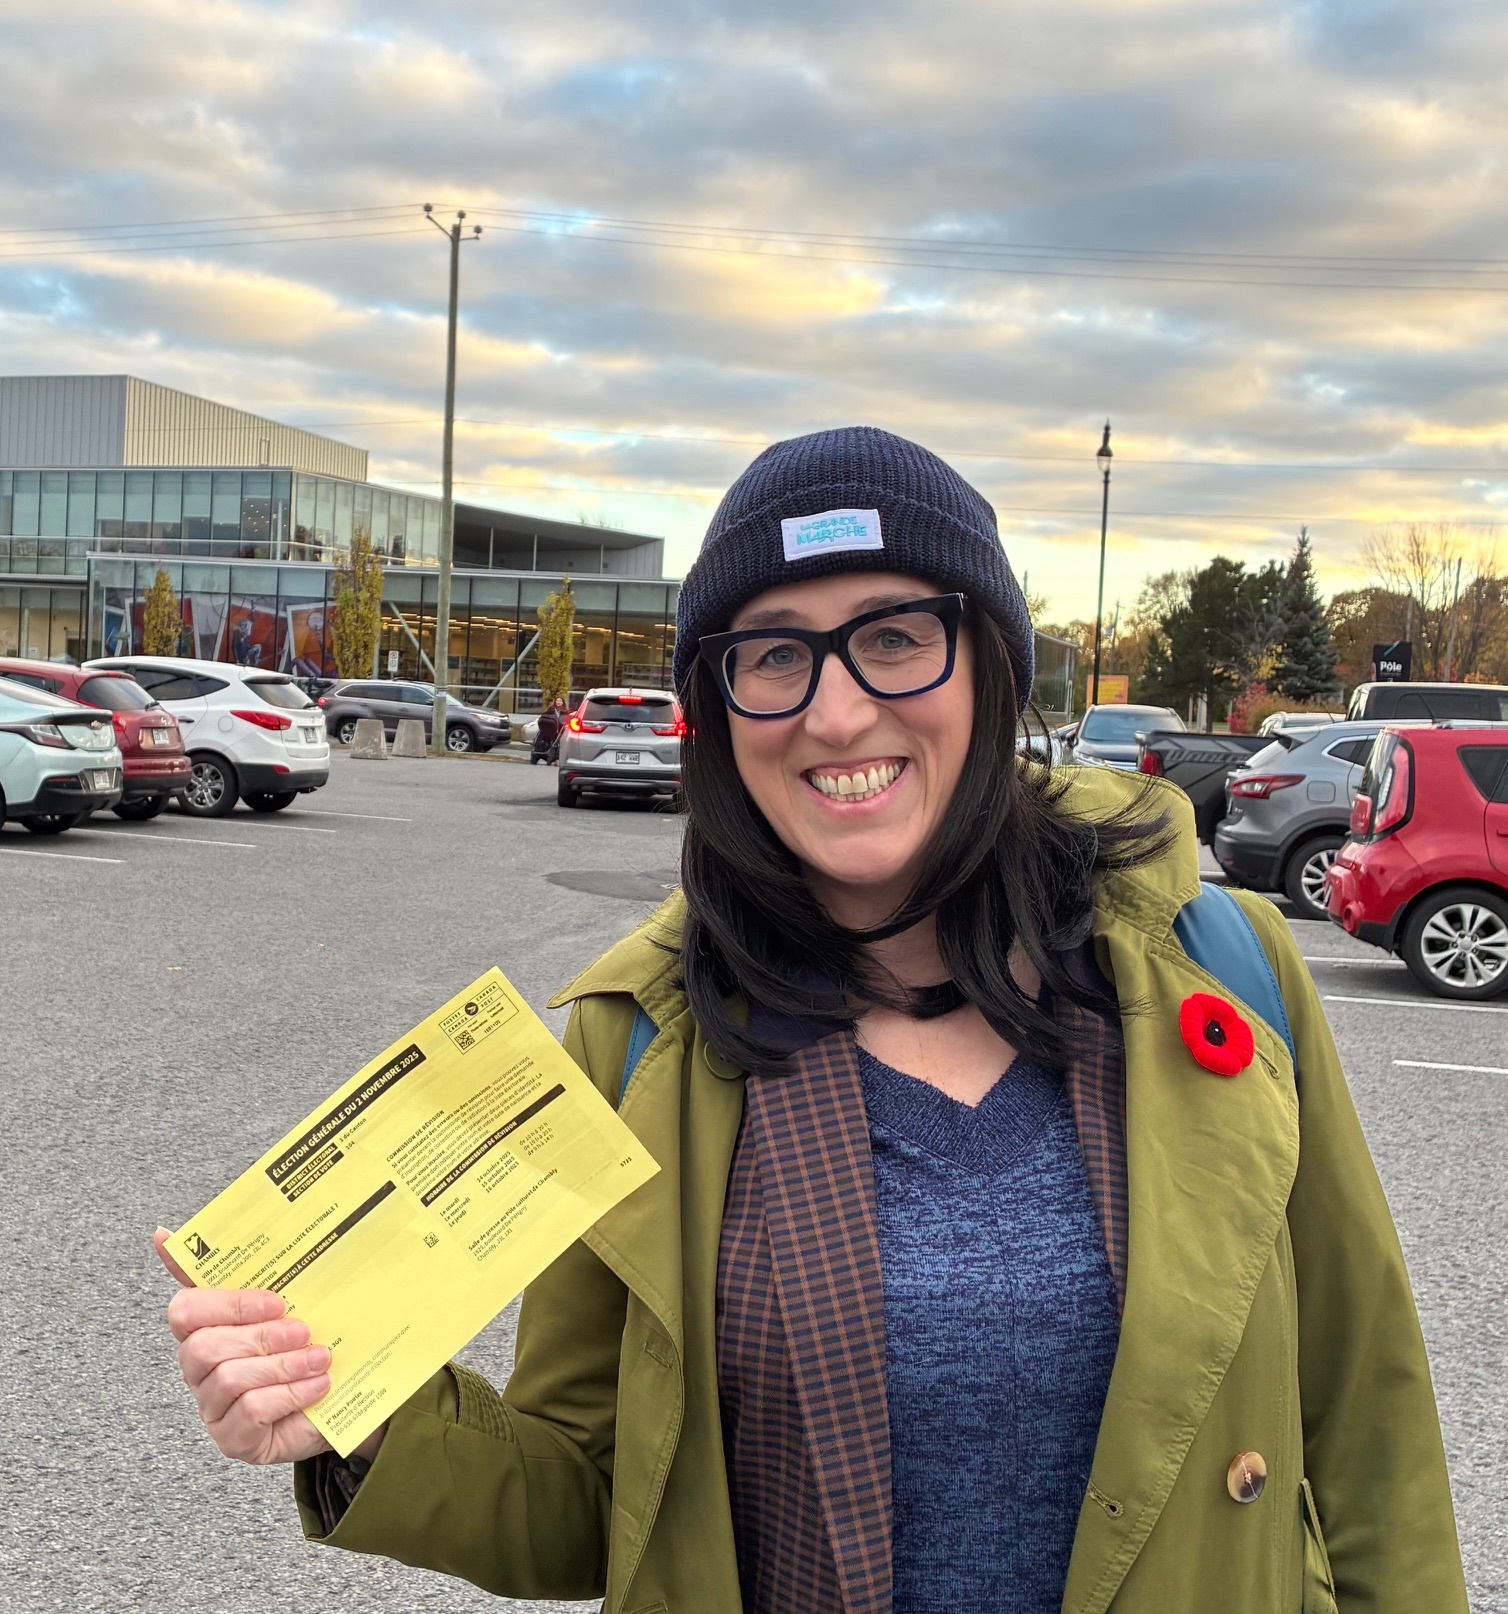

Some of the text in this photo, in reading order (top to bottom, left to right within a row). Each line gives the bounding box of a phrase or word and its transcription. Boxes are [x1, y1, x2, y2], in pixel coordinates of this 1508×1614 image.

[797, 525, 867, 545] MARCHE
[1380, 661, 1402, 672] Pôle
[475, 985, 496, 1001] CANADA
[480, 996, 493, 1007] POST
[447, 1016, 468, 1032] CANADA
[272, 1143, 309, 1178] ÉLECTION
[308, 1111, 346, 1146] GÉNÉRALE
[343, 1101, 356, 1115] DU
[360, 1064, 401, 1100] NOVEMBRE
[399, 1050, 419, 1068] 2025
[386, 1109, 444, 1162] COMMISSION DE RÉVISION
[286, 1145, 335, 1189] DISTRICT ÉLECTORAL
[425, 1180, 447, 1201] HORAIRE
[458, 1143, 488, 1171] COMMISSION
[486, 1137, 495, 1146] DE
[493, 1120, 517, 1140] RÉVISION
[293, 1176, 314, 1197] SECTION
[319, 1159, 333, 1172] VOTE
[537, 1168, 557, 1186] Chambly
[275, 1249, 286, 1260] SUR
[292, 1231, 306, 1245] LISTE
[304, 1205, 335, 1233] ÉLECTORALE
[195, 1247, 220, 1270] CHAMBLY
[218, 1245, 240, 1264] Chambly
[300, 1250, 317, 1265] CETTE
[315, 1232, 338, 1253] ADRESSE
